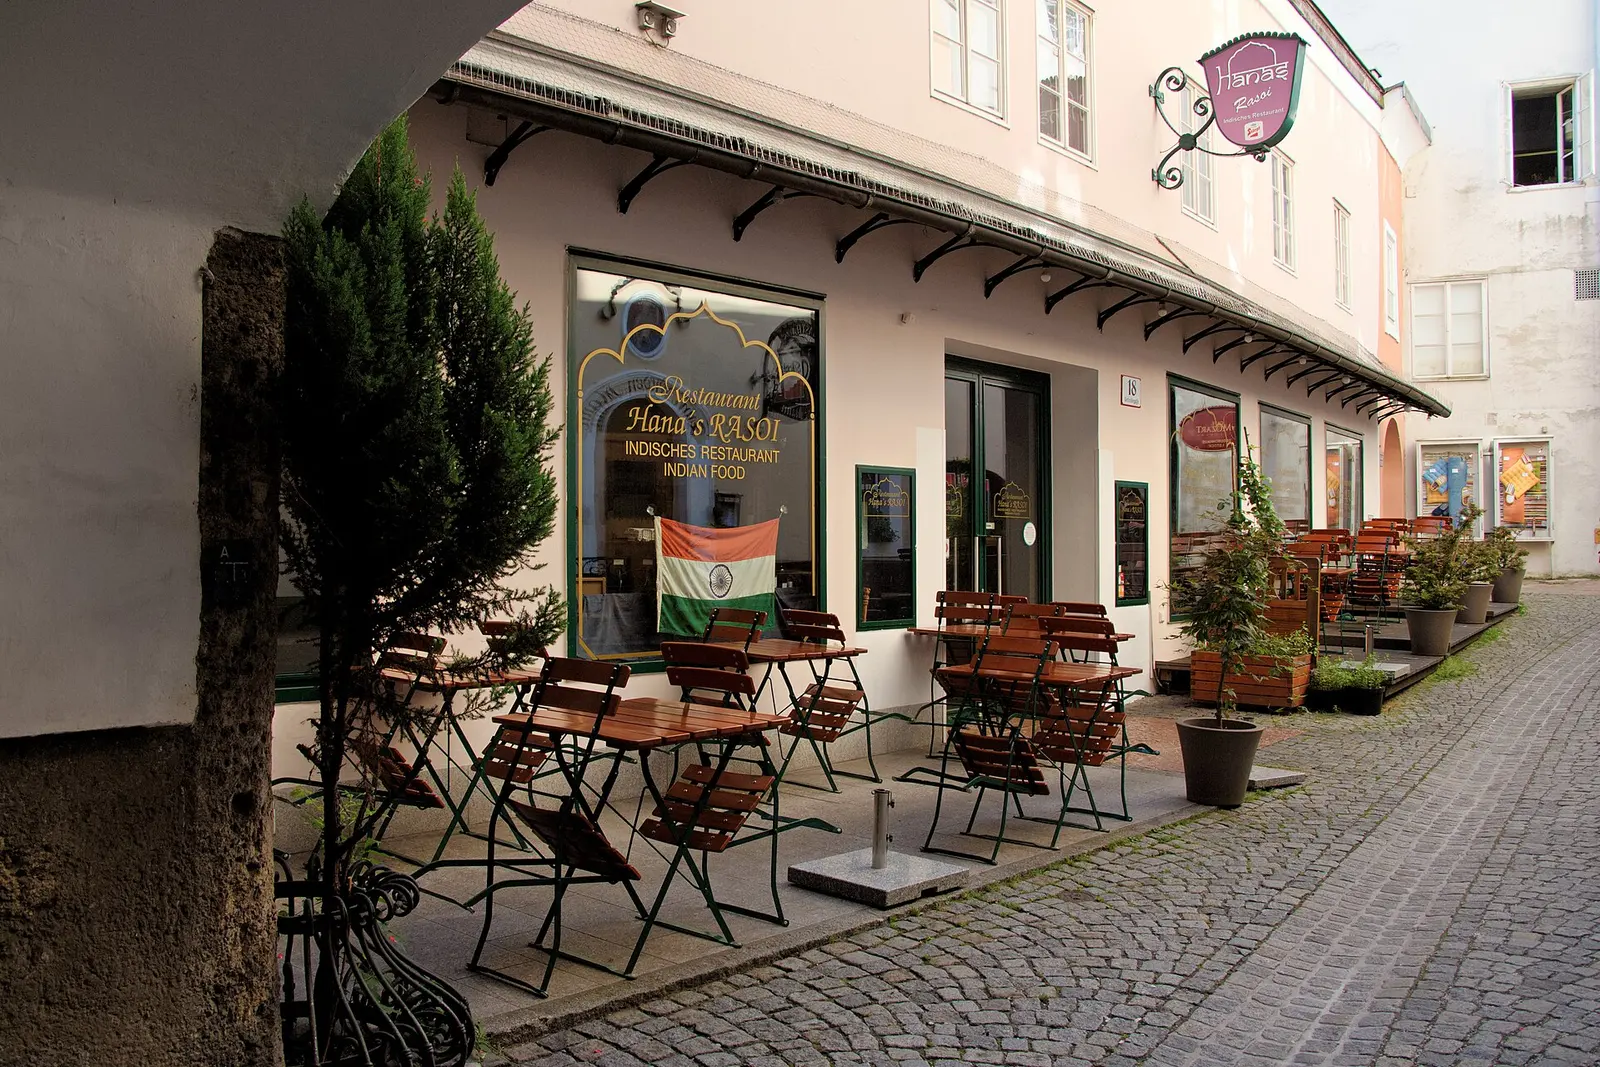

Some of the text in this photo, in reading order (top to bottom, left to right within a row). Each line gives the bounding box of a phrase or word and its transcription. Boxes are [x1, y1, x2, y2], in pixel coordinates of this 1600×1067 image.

[1234, 87, 1272, 113] Rasoi
[1252, 107, 1284, 119] Restaurant
[649, 375, 761, 411] Restaurant
[1127, 379, 1137, 396] 18
[709, 413, 781, 443] RASOI
[625, 440, 780, 464] INDISCHES RESTAURANT
[664, 462, 745, 480] INDIAN FOOD
